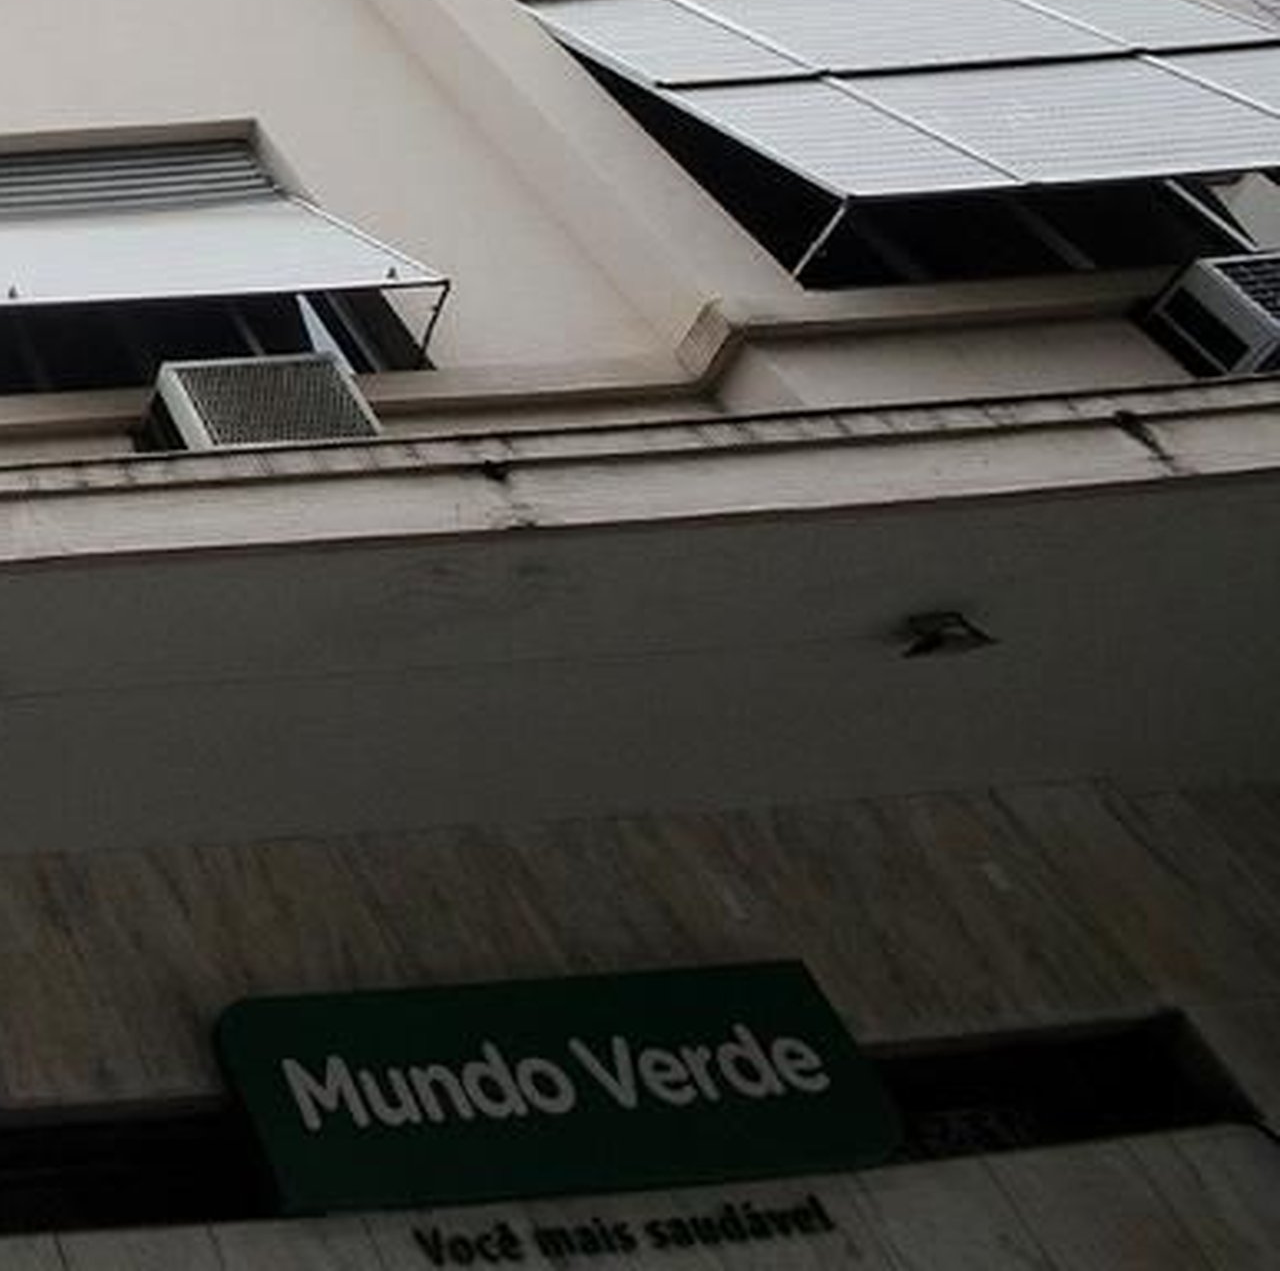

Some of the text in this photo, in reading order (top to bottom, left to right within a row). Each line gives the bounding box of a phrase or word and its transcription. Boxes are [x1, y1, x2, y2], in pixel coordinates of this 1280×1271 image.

[281, 1023, 831, 1131] Mundo Verde
[414, 1194, 834, 1265] Você mais saudável
